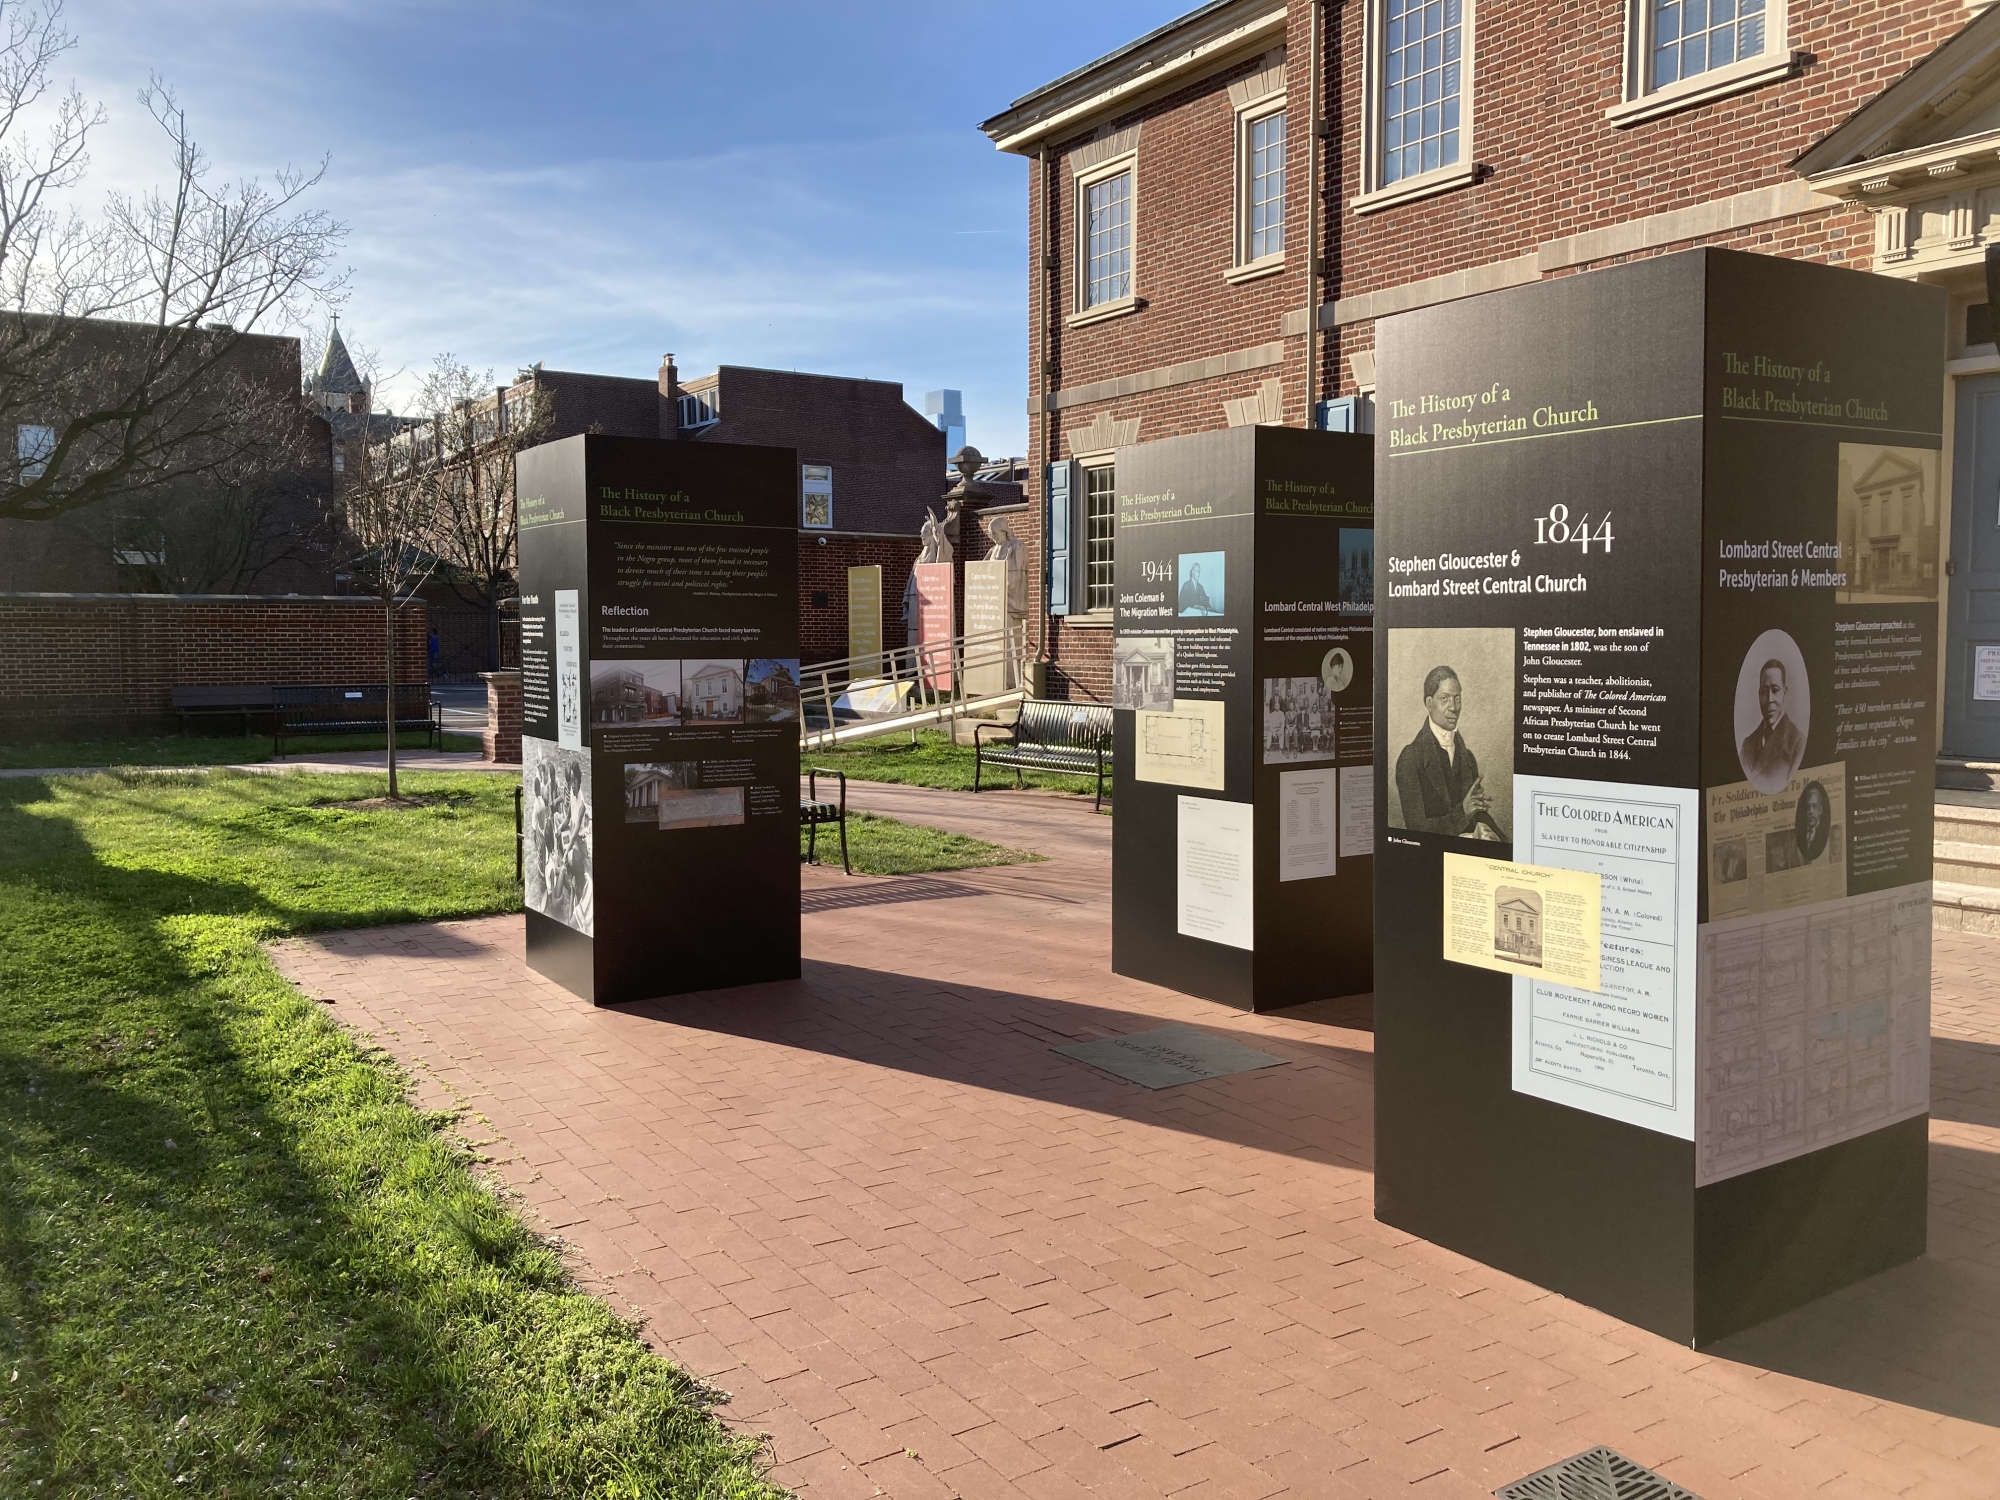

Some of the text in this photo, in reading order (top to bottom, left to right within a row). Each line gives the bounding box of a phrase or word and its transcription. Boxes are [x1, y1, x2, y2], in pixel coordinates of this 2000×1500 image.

[1723, 352, 1831, 383] The History of a
[1390, 383, 1511, 418] The History of a
[1722, 387, 1888, 421] Black Presbyterian Church
[1390, 400, 1599, 448] Black Presbyterian Church
[600, 487, 621, 499] The
[625, 488, 667, 503] History
[670, 491, 682, 502] of
[1266, 479, 1283, 492] The
[1285, 481, 1318, 495] History
[1320, 482, 1329, 494] of
[1121, 489, 1175, 506] The History of a
[1266, 498, 1290, 510] Black
[1292, 499, 1343, 513] Presbyterian
[550, 508, 564, 520] Church
[600, 505, 744, 522] Black Presbyterian Church
[1121, 502, 1212, 523] Black Presbyterian Church
[1534, 504, 1615, 554] 1844
[1720, 540, 1842, 559] Lombard Street Central
[1141, 559, 1173, 582] 1944
[1389, 549, 1521, 576] Stephen Gloucester &
[1389, 574, 1586, 597] Lombard Street Central Church
[1720, 569, 1847, 589] Presbyterian & Members
[1120, 592, 1164, 604] John Coleman &
[602, 606, 649, 616] Reflection
[1120, 606, 1173, 619] The Migration West
[1265, 601, 1374, 613] Lombard Central West Philadelp
[1524, 626, 1664, 639] Stephen Gloucester, born enslaved in
[1523, 641, 1560, 651] Tennessee
[1562, 641, 1569, 651] in
[1570, 641, 1591, 652] 1802,
[1610, 642, 1622, 652] the
[1640, 642, 1650, 652] of
[1523, 656, 1582, 667] John Gloucester.
[1523, 674, 1552, 686] Stephen
[1575, 675, 1604, 686] teacher,
[1605, 676, 1652, 687] abolitionist,
[1523, 688, 1666, 702] and publisher of The Colored American
[1523, 704, 1647, 716] newspaper. As minister of Second
[1523, 716, 1549, 726] African
[1551, 717, 1595, 730] Presbyterian
[1597, 720, 1627, 730] Church
[1629, 721, 1639, 731] he
[1566, 732, 1601, 743] Lombard
[1603, 734, 1625, 745] Street
[1627, 736, 1657, 746] Central
[1523, 744, 1631, 760] Presbyterian Church in 1844.
[1713, 800, 1796, 824] The Philadelphia Tribune
[1536, 988, 1668, 1022] CLUB MOVEMENT AMONG NEGRO WOMEN
